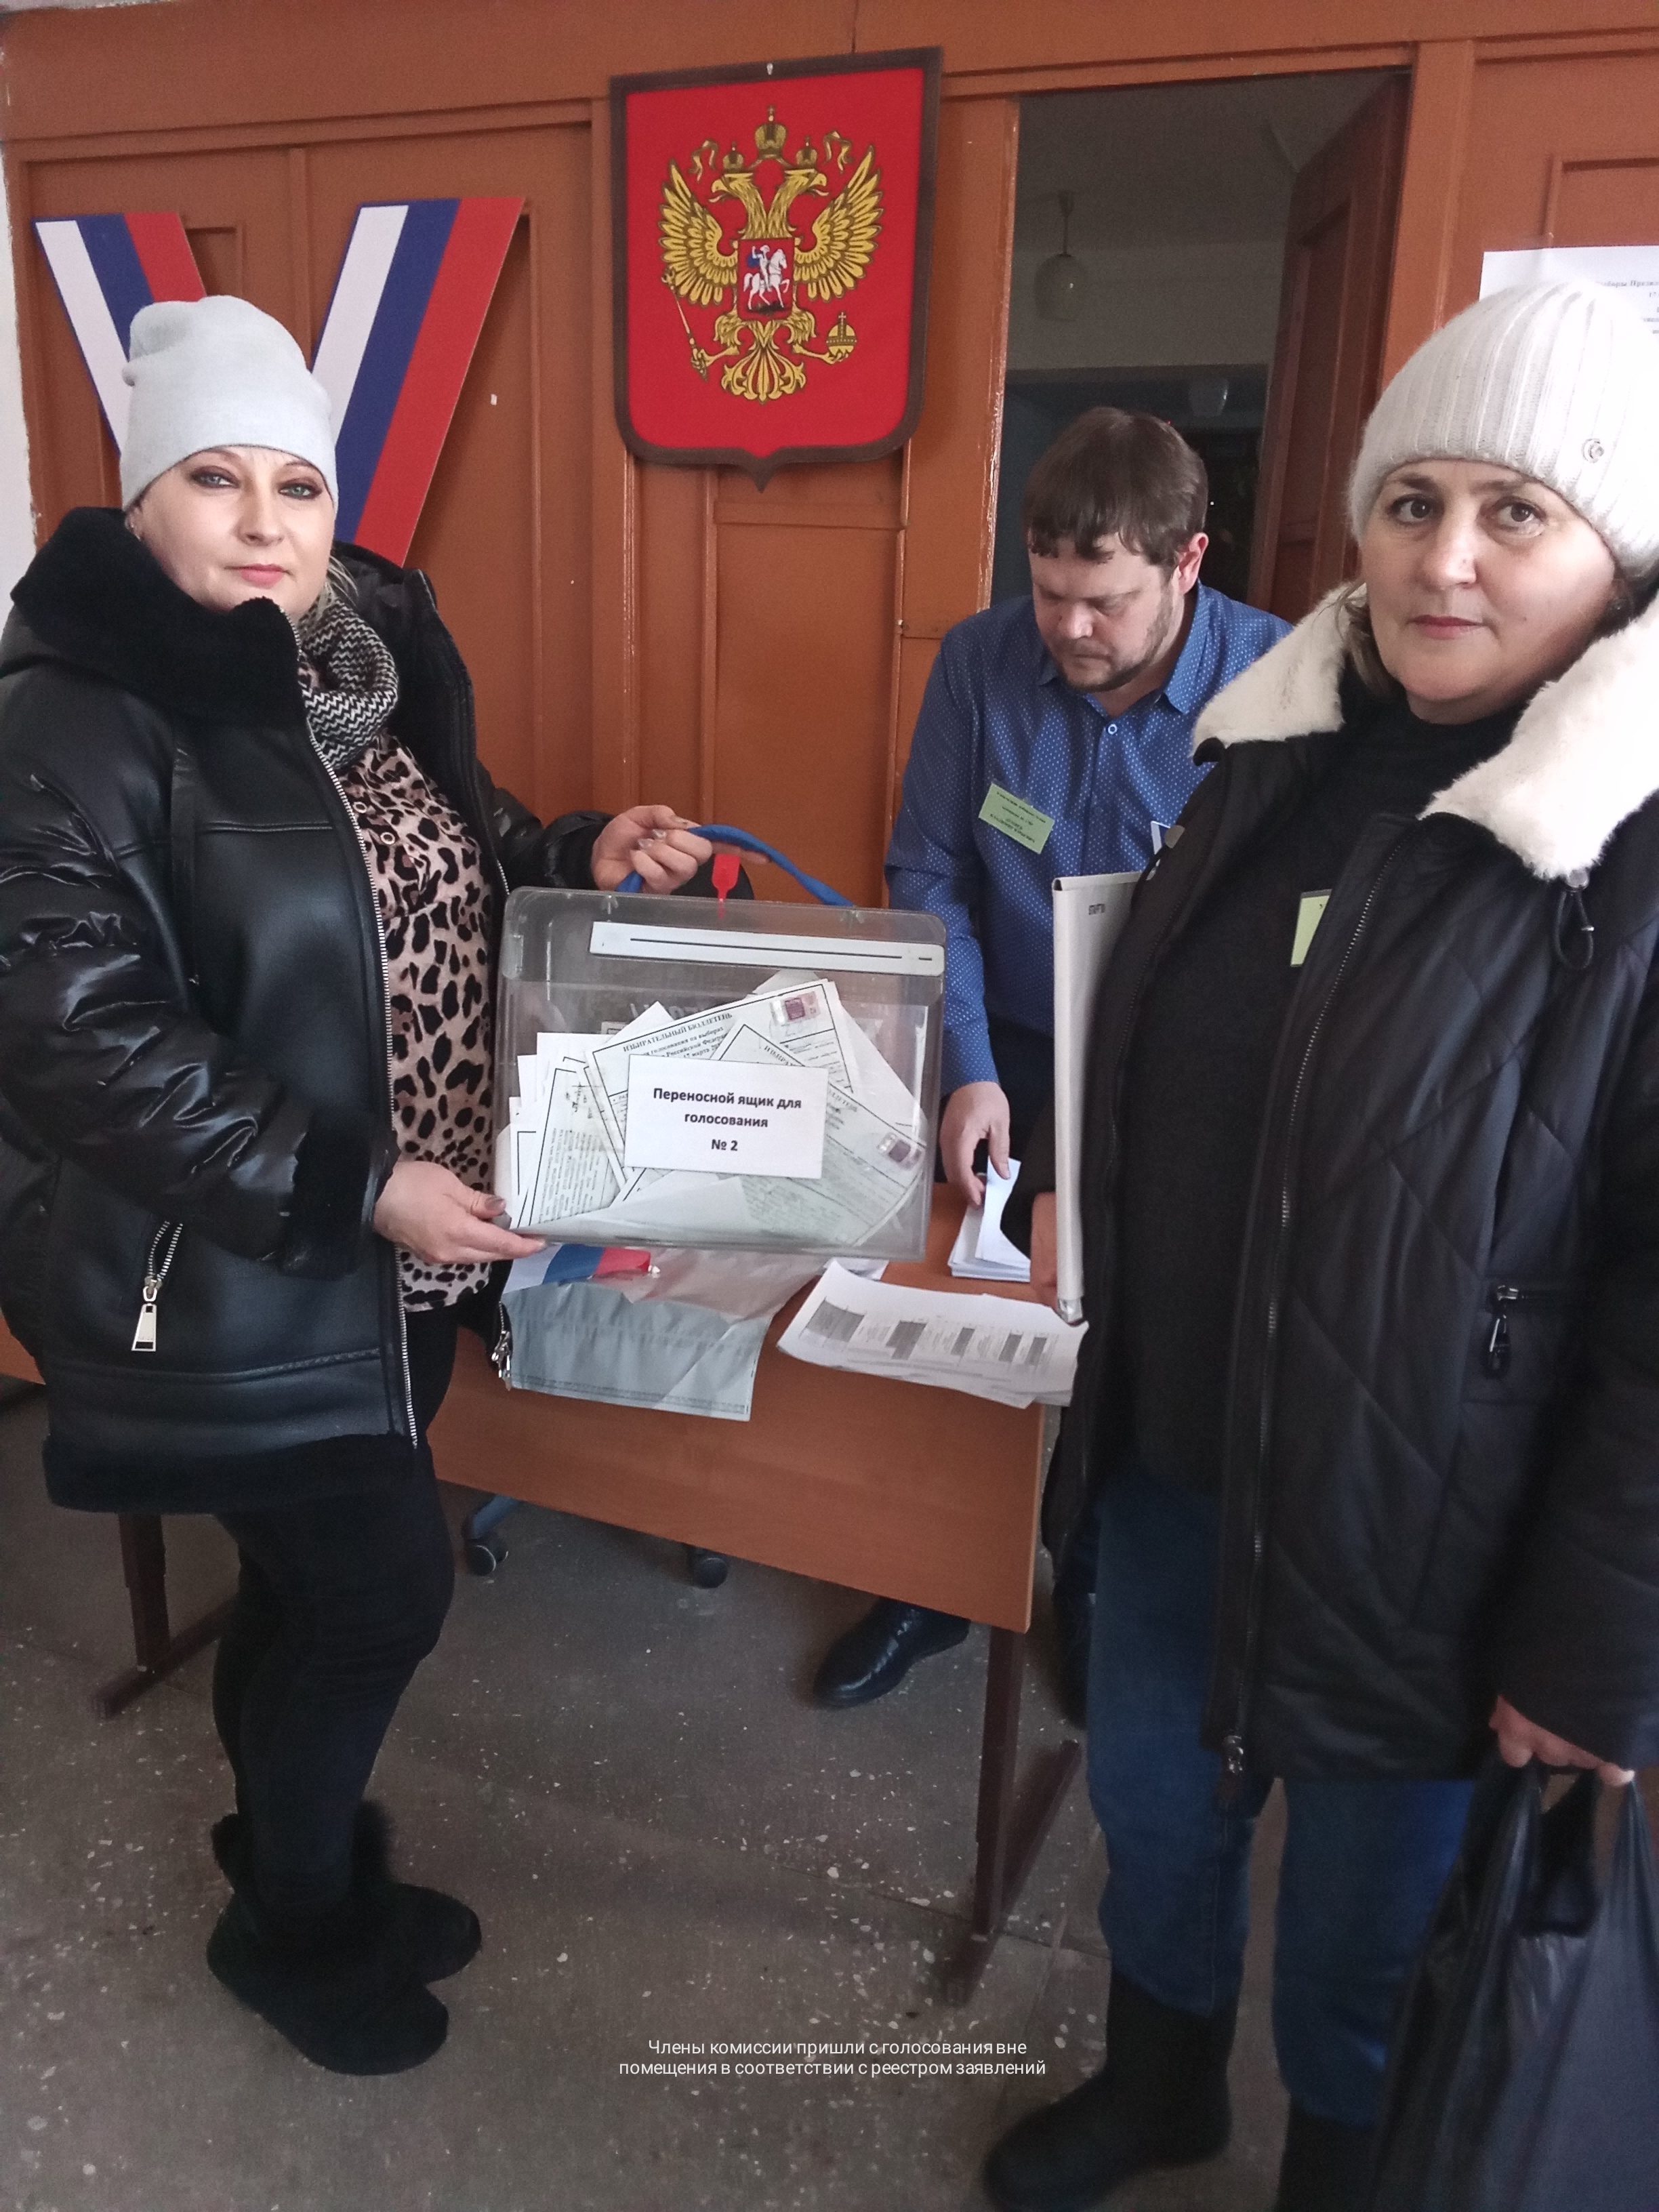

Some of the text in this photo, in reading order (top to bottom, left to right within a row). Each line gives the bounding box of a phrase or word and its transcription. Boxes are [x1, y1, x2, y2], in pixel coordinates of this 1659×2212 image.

[653, 1088, 802, 1109] Переносной ящик для
[684, 1113, 769, 1128] голосования
[711, 1139, 738, 1151] № 2
